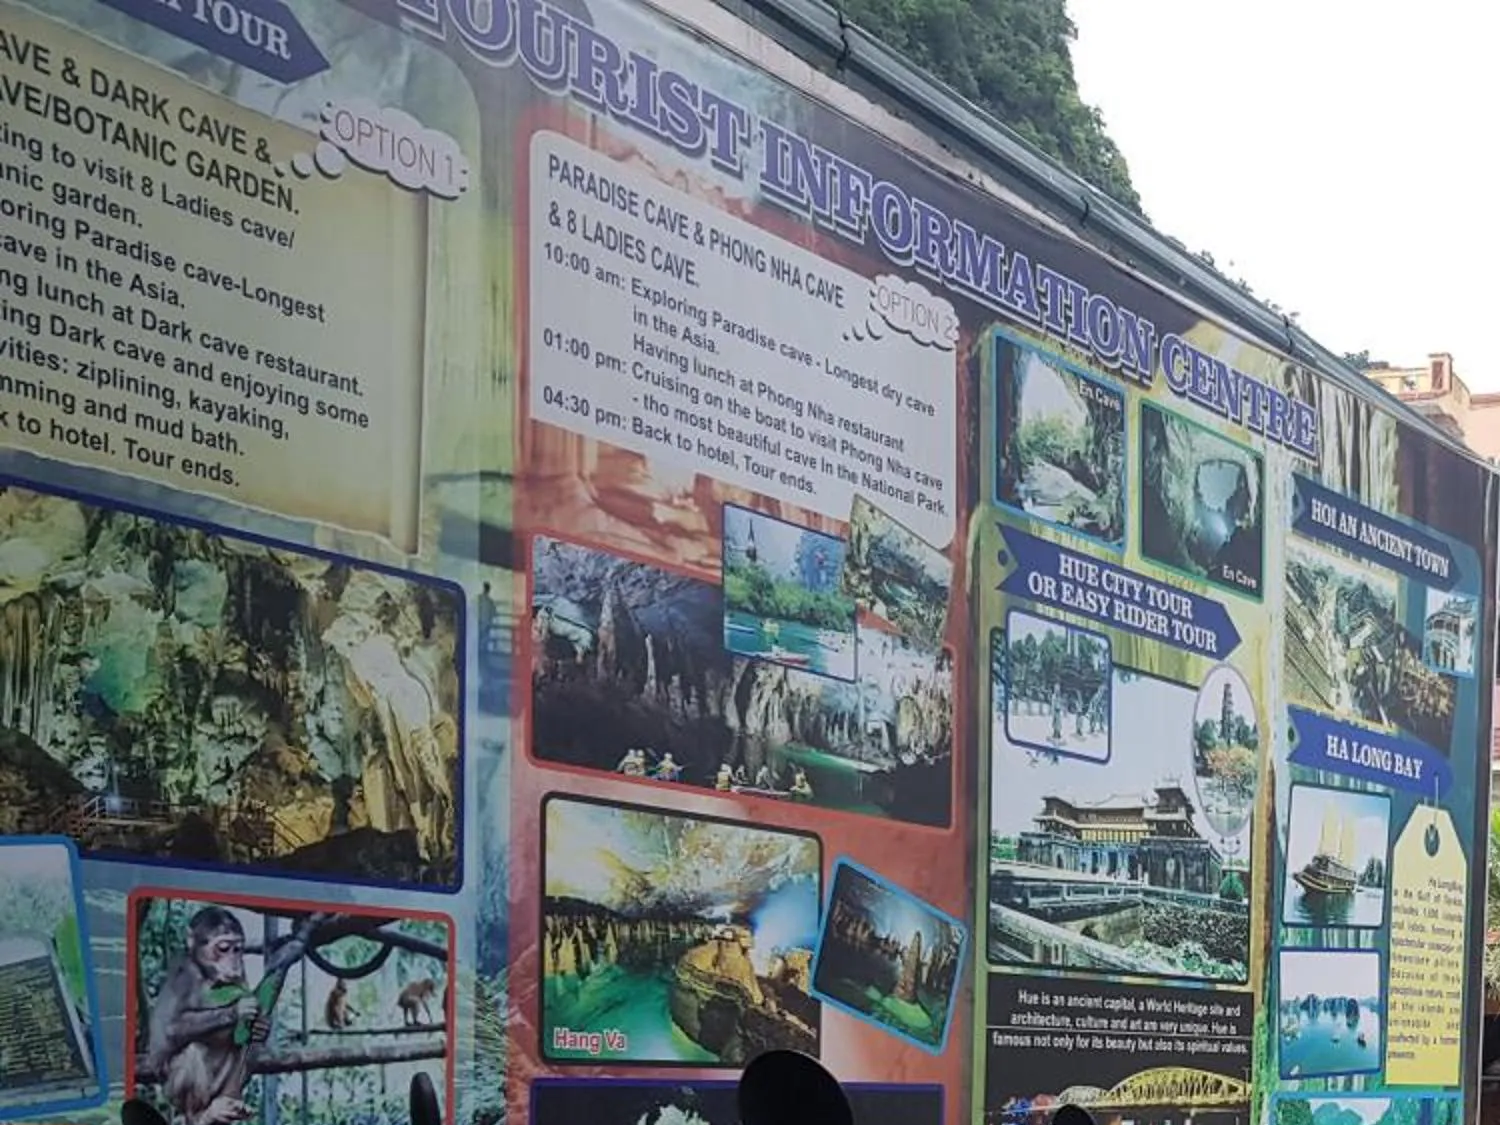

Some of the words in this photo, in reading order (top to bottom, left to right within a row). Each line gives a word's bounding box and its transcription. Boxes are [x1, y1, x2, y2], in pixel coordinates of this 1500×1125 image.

[193, 0, 291, 60] TOUR
[0, 75, 177, 167] VE/BOTANIC
[186, 151, 300, 214] GARDEN.
[61, 57, 81, 88] &
[90, 69, 171, 125] DARK
[178, 107, 247, 155] CAVE
[255, 137, 273, 165] &
[335, 109, 435, 178] OPTION
[445, 155, 455, 186] 1
[51, 142, 76, 168] to
[83, 157, 134, 190] visit
[141, 175, 154, 197] 8
[162, 182, 234, 228] Ladies
[240, 214, 295, 250] cave/
[52, 182, 143, 228] garden.
[549, 153, 639, 218] PARADISE
[643, 199, 689, 240] CAVE
[693, 221, 705, 246] &
[709, 228, 767, 273] PHONG
[770, 255, 802, 291] NHA
[805, 272, 845, 309] CAVE
[56, 247, 77, 273] in
[86, 259, 123, 288] the
[129, 273, 186, 308] Asia.
[75, 219, 177, 272] Paradise
[183, 262, 326, 323] cave-Longest
[549, 201, 561, 227] &
[567, 208, 577, 234] 8
[582, 214, 646, 264] LADIES
[651, 246, 700, 287] CAVE.
[544, 241, 591, 276] 10:00
[595, 265, 625, 290] am:
[632, 277, 707, 327] Exploring
[712, 310, 776, 351] Paradise
[780, 342, 813, 368] cave
[825, 357, 879, 395] Longest
[881, 383, 903, 407] dry
[905, 395, 935, 417] cave
[633, 304, 648, 327] in
[653, 313, 677, 338] the
[681, 326, 720, 355] Asia.
[758, 117, 1159, 385] INFORMATION
[1160, 331, 1319, 460] CENTRE
[877, 285, 939, 332] OPTION
[37, 275, 104, 316] lunch
[112, 304, 134, 325] at
[142, 308, 193, 343] Dark
[200, 332, 249, 360] cave
[255, 350, 364, 397] restaurant.
[50, 314, 106, 351] Dark
[113, 339, 166, 368] cave
[173, 356, 213, 382] and
[221, 371, 309, 416] enjoying
[315, 399, 369, 429] some
[76, 360, 181, 409] ziplining,
[189, 389, 289, 440] kayaking,
[84, 398, 127, 424] and
[135, 411, 184, 440] mud
[192, 422, 245, 456] bath.
[543, 328, 590, 360] 01:00
[595, 351, 627, 374] pm:
[632, 361, 699, 405] Cruising
[703, 390, 723, 411] on
[727, 398, 751, 419] the
[755, 406, 787, 433] boat
[790, 421, 805, 439] to
[808, 430, 837, 452] visit
[840, 439, 883, 472] Phong
[887, 456, 912, 480] Nha
[913, 470, 943, 491] cave
[633, 333, 689, 373] Having
[693, 355, 735, 388] lunch
[739, 376, 754, 394] at
[757, 381, 804, 417] Phong
[807, 401, 835, 425] Nha
[837, 416, 905, 452] restaurant
[17, 411, 42, 435] to
[50, 418, 116, 456] hotel.
[123, 437, 175, 470] Tour
[181, 457, 241, 487] ends.
[543, 385, 590, 417] 04:30
[595, 407, 627, 430] pm:
[632, 416, 672, 446] Back
[677, 433, 693, 452] to
[743, 454, 776, 481] Tour
[779, 470, 817, 495] ends.
[674, 408, 713, 433] most
[717, 420, 781, 457] beautiful
[785, 447, 817, 470] cave
[837, 463, 859, 485] the
[861, 472, 914, 504] National
[1311, 498, 1337, 529] HOI
[1338, 511, 1358, 539] AN
[1359, 521, 1413, 563] ANCIENT
[1414, 544, 1450, 579] TOWN
[1027, 571, 1059, 601] OR
[1061, 582, 1111, 618] EASY
[1113, 600, 1171, 638] RIDER
[1171, 619, 1217, 653] TOUR
[1058, 553, 1099, 588] HUE
[1101, 569, 1144, 601] CITY
[1145, 584, 1194, 620] TOUR
[1326, 734, 1349, 762] HA
[1351, 741, 1393, 773] LONG
[1394, 753, 1424, 780] BAY
[1018, 989, 1039, 1005] Hue
[553, 1026, 601, 1054] Hang
[604, 1030, 628, 1051] Va
